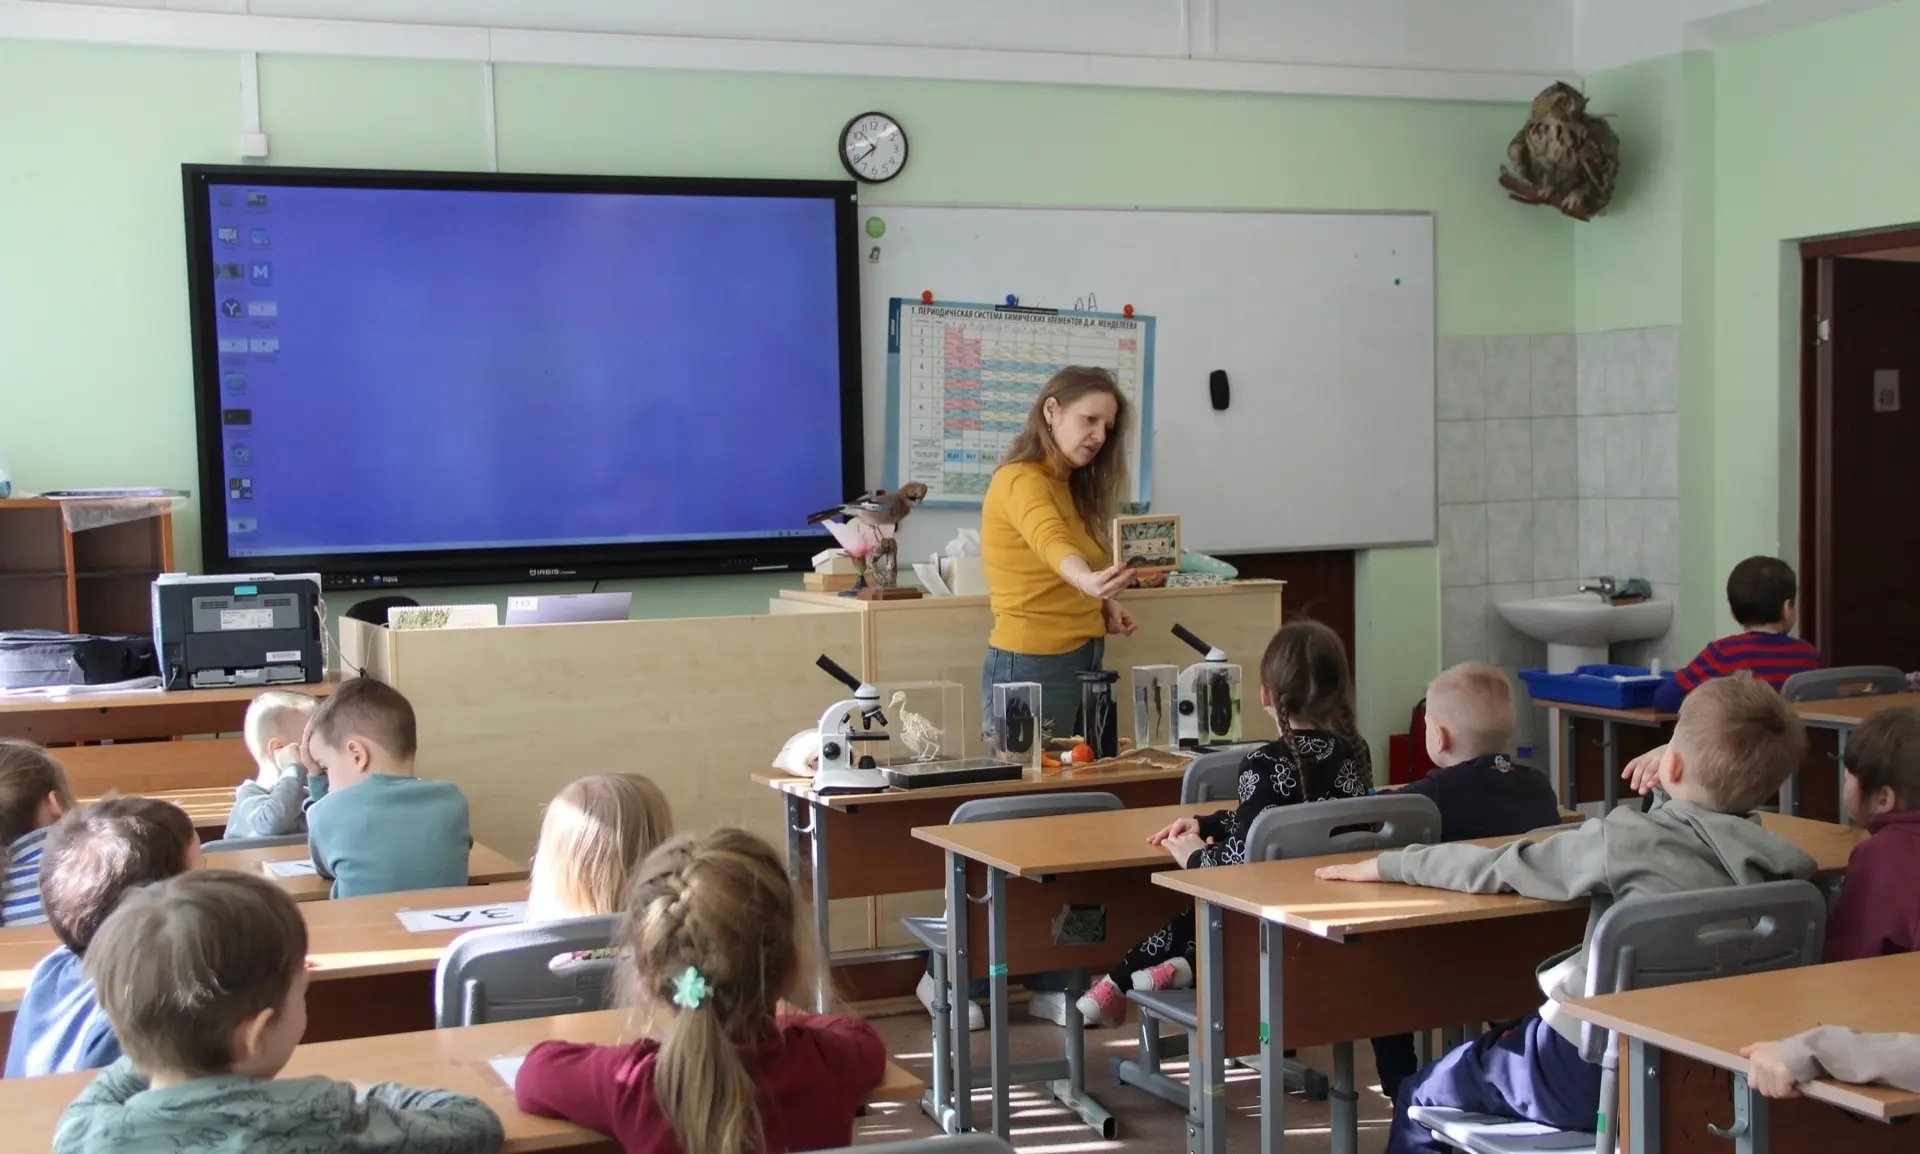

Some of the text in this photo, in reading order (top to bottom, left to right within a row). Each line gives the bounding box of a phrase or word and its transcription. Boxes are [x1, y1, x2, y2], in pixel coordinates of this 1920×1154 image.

[862, 123, 868, 132] 11
[870, 121, 879, 130] 12
[853, 131, 863, 140] 10
[889, 133, 896, 141] 2
[894, 144, 899, 153] 3
[889, 156, 895, 165] 4
[861, 162, 867, 171] 7
[871, 166, 878, 175] 6
[882, 163, 888, 172] 5
[225, 302, 238, 316] Y
[918, 307, 973, 318] ПЕРИОДИЧЕСКАЯ
[974, 310, 1003, 320] СИСТЕМА
[1004, 312, 1045, 322] ХИМИЧЕСКИХ
[1047, 316, 1082, 326] ЭЛЕМЕНТОВ
[1098, 319, 1137, 330] МЕНДЕЛЕЕВА
[537, 568, 560, 576] IRBIS
